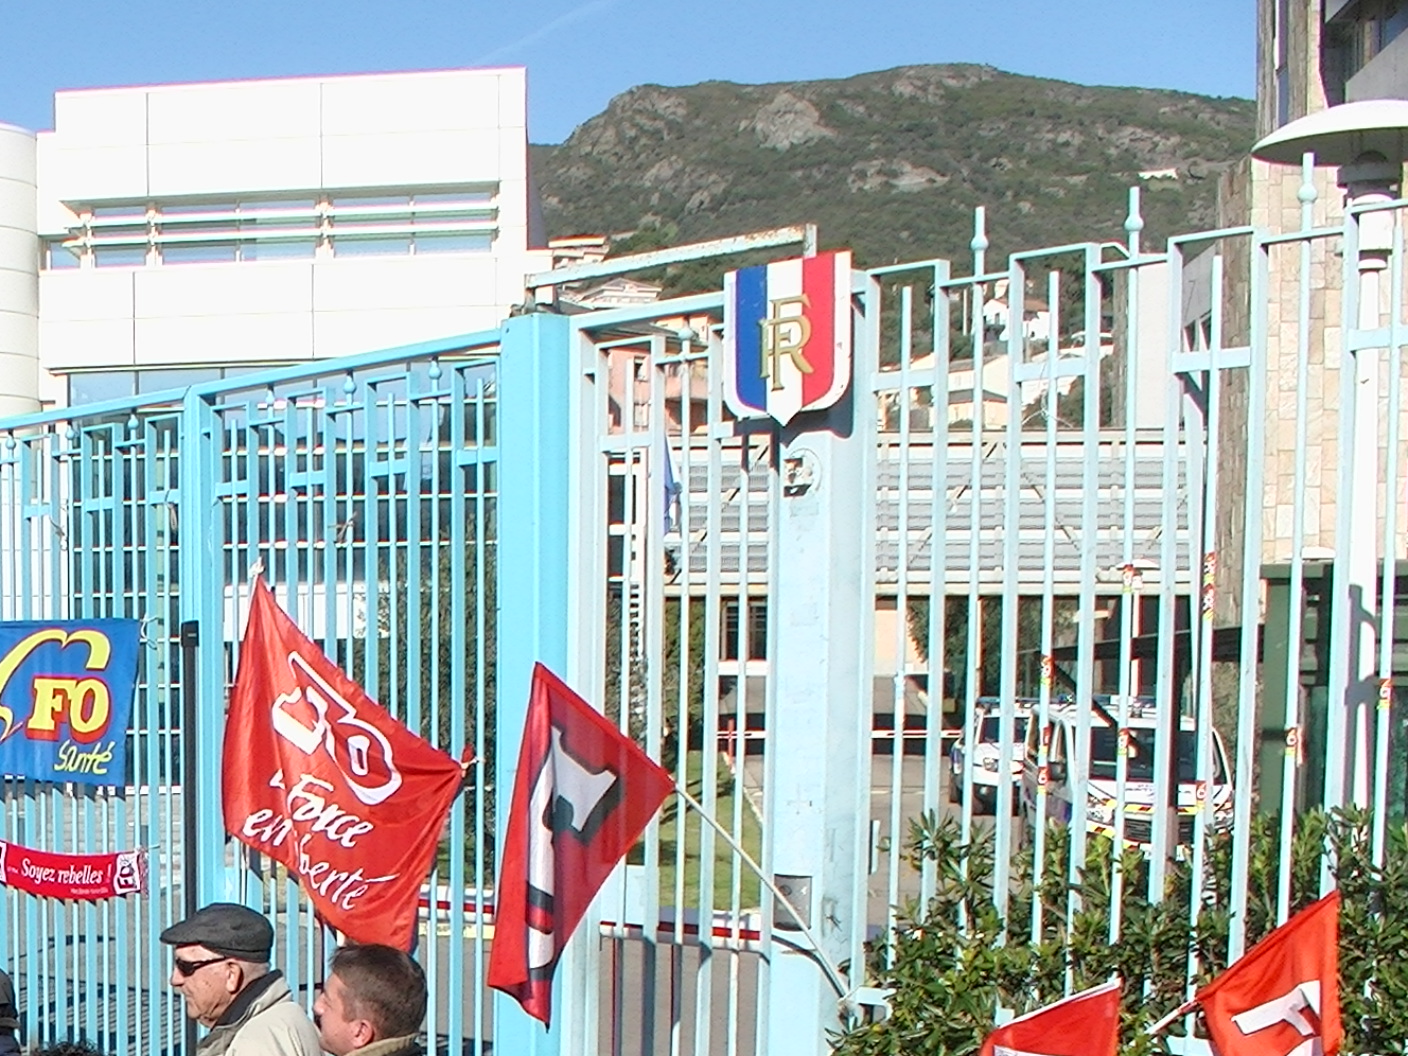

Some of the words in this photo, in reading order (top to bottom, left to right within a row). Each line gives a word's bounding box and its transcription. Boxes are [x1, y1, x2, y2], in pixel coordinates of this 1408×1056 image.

[25, 674, 110, 743] FO
[242, 808, 293, 846] en
[21, 857, 56, 884] Soyez
[58, 864, 104, 885] rebelles
